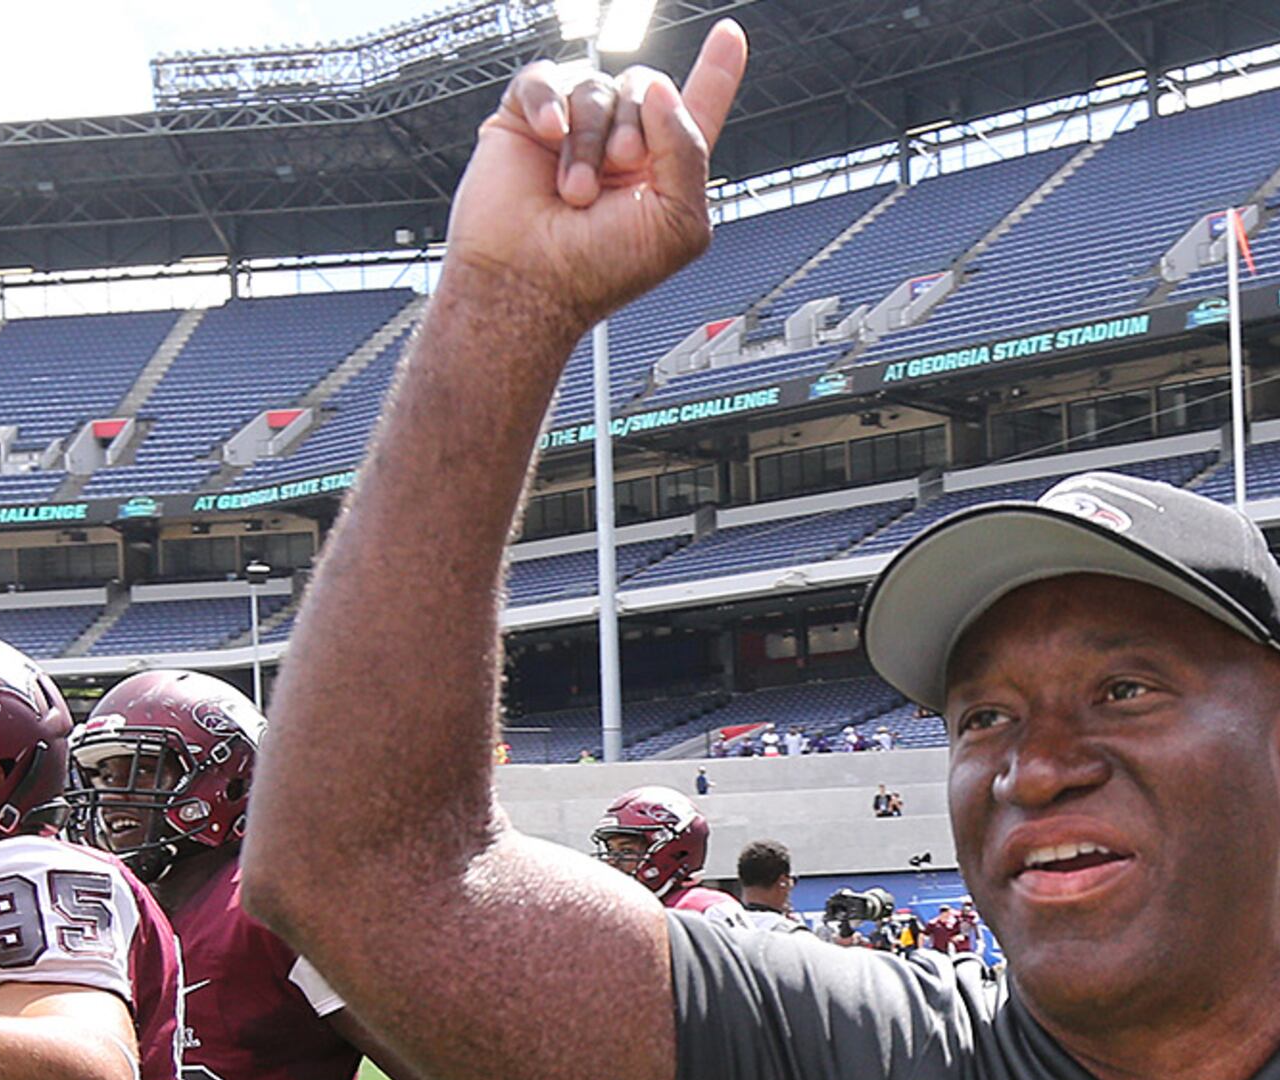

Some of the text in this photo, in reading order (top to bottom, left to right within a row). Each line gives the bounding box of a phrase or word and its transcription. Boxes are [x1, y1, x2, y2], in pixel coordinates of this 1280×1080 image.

[883, 315, 1150, 382] AT GEORGIA STATE STADIUM
[550, 428, 578, 447] THE
[680, 387, 780, 422] CHALLENGE
[193, 471, 357, 512] AT GEORGIA STATE STAD
